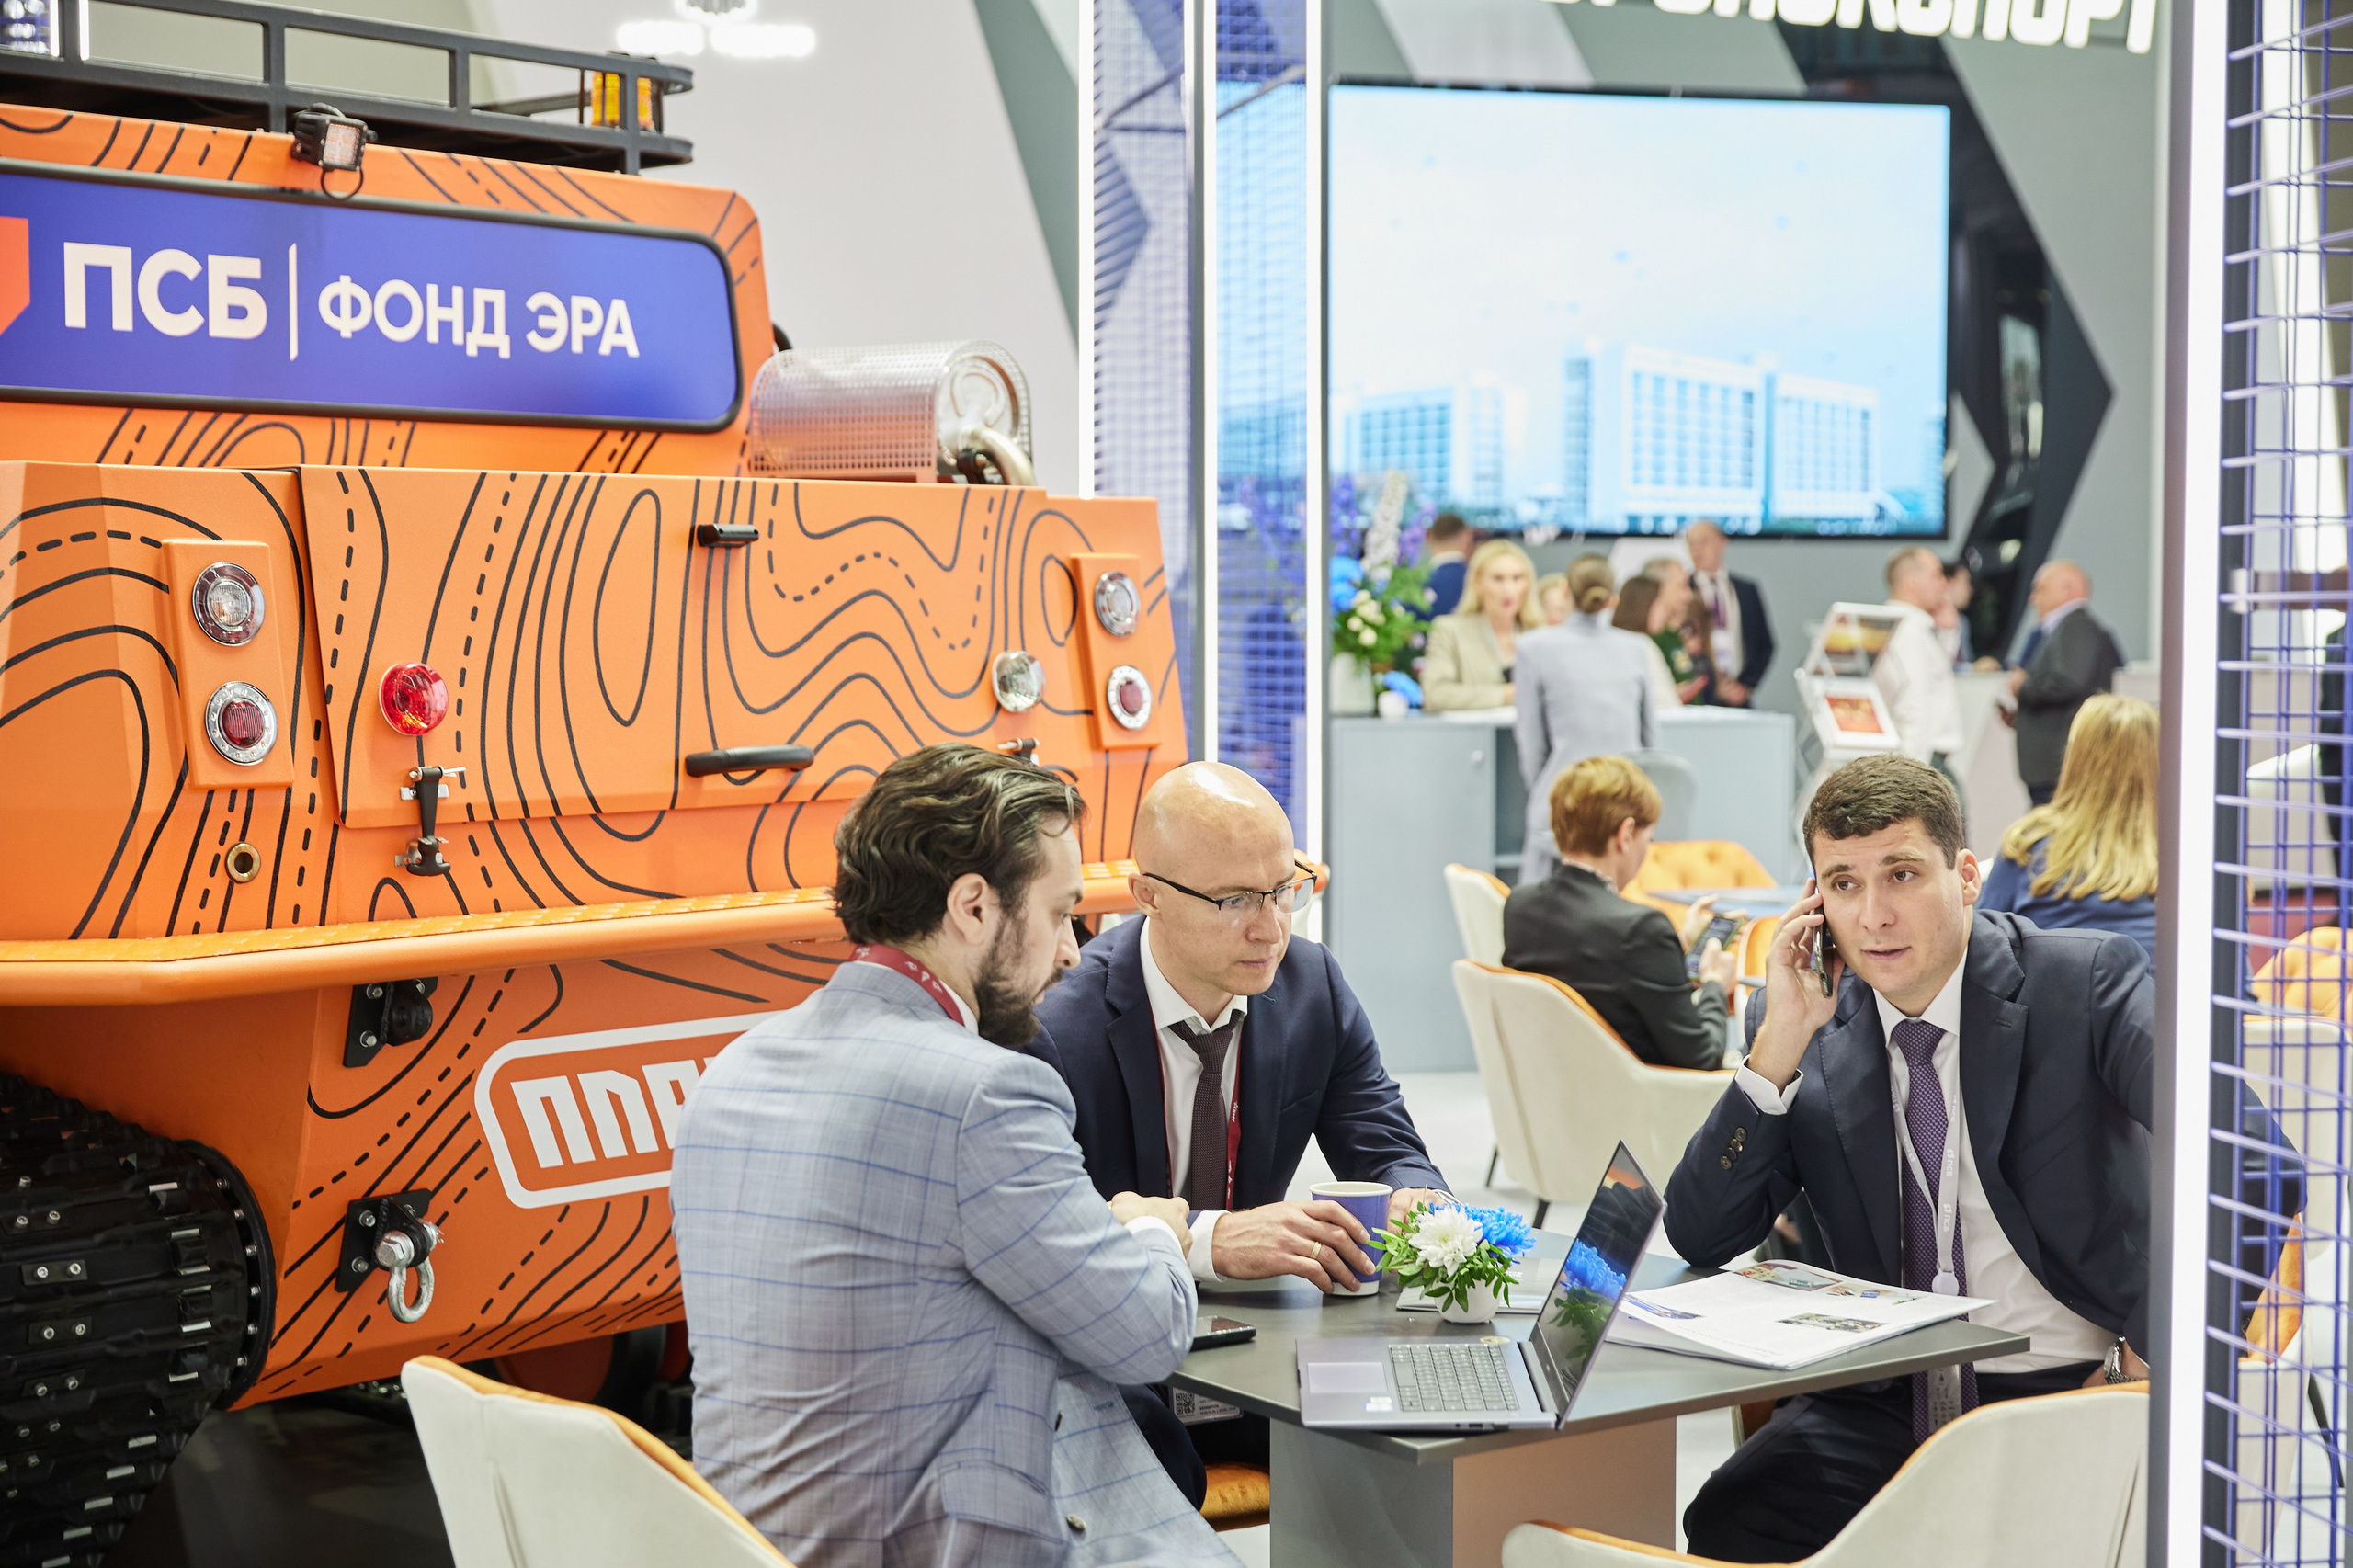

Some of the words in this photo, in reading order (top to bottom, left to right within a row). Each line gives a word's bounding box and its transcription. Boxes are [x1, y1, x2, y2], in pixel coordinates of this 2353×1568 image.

[63, 242, 268, 340] ПСБ
[318, 275, 510, 359] ФОНД
[526, 292, 640, 358] ЭРА
